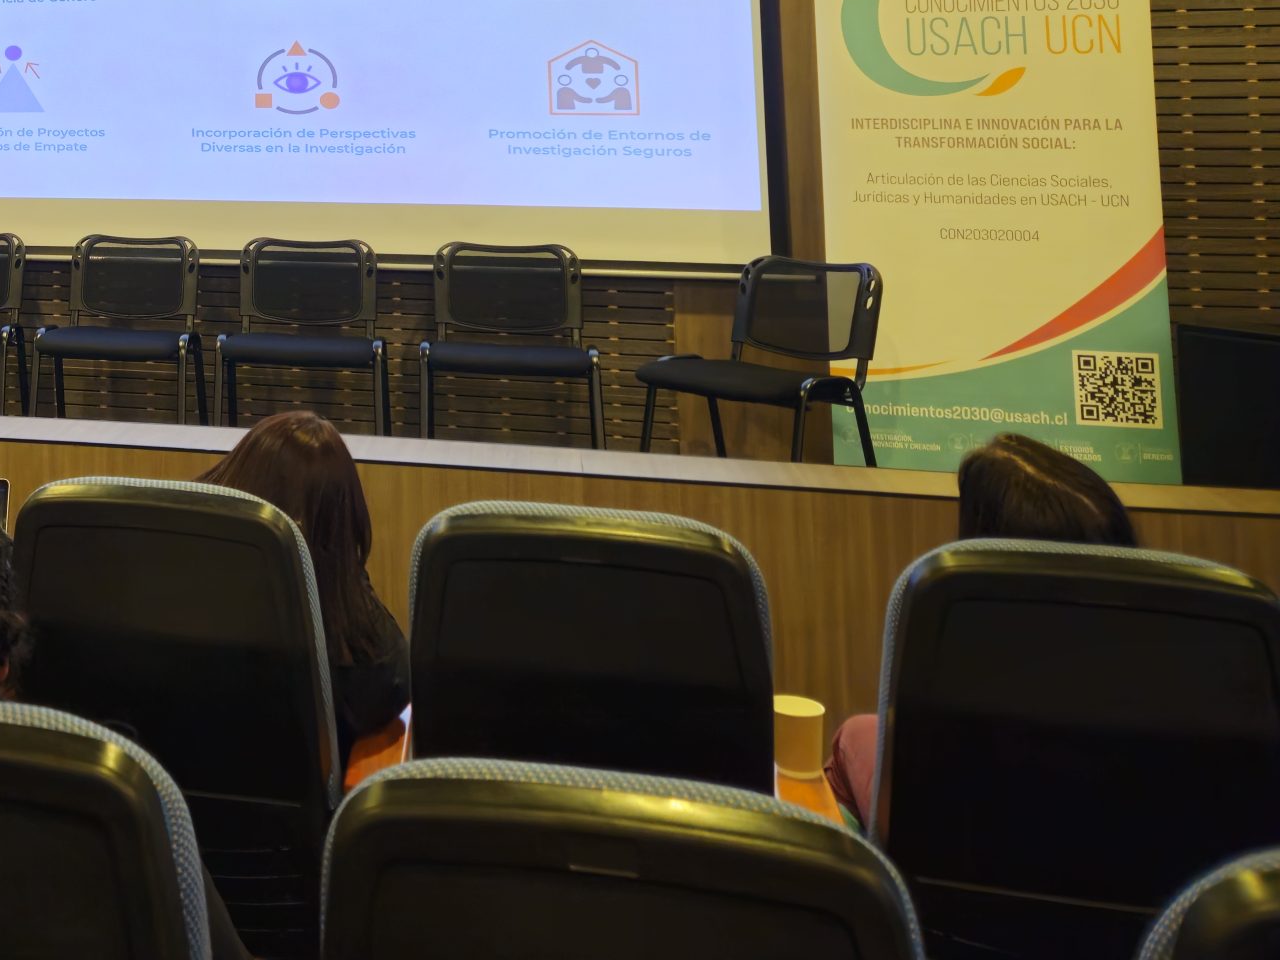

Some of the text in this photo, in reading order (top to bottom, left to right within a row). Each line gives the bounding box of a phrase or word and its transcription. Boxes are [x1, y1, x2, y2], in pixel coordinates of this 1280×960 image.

[905, 13, 1122, 57] USACH UCN
[850, 116, 1123, 131] INTERDISCIPLINA E INNOVACIÓN PARA LA
[16, 127, 33, 137] de
[37, 127, 106, 139] Proyectos
[191, 127, 416, 140] Incorporación de Perspectivas
[488, 128, 711, 141] Promoción de Entornos de
[13, 142, 30, 151] de
[34, 142, 88, 153] Empate
[200, 142, 406, 155] Diversas en la Investigación
[895, 134, 1076, 150] TRANSFORMACIÓN SOCIAL:
[507, 144, 692, 159] Investigación Seguros
[866, 172, 1112, 189] Articulación de las Ciencias Sociales,
[852, 190, 910, 204] Jurídicas
[913, 195, 921, 206] y
[923, 192, 1017, 206] Humanidades
[1020, 197, 1038, 207] en
[1041, 194, 1088, 207] USACH
[1100, 195, 1130, 208] UCN
[939, 228, 1040, 242] CON203020004
[846, 402, 1068, 426] cnocimientos2030@usach.cl
[872, 432, 913, 442] VESTIGACIÓN,
[872, 440, 904, 449] NOVACIÓN
[1066, 453, 1102, 462] ANZADOS
